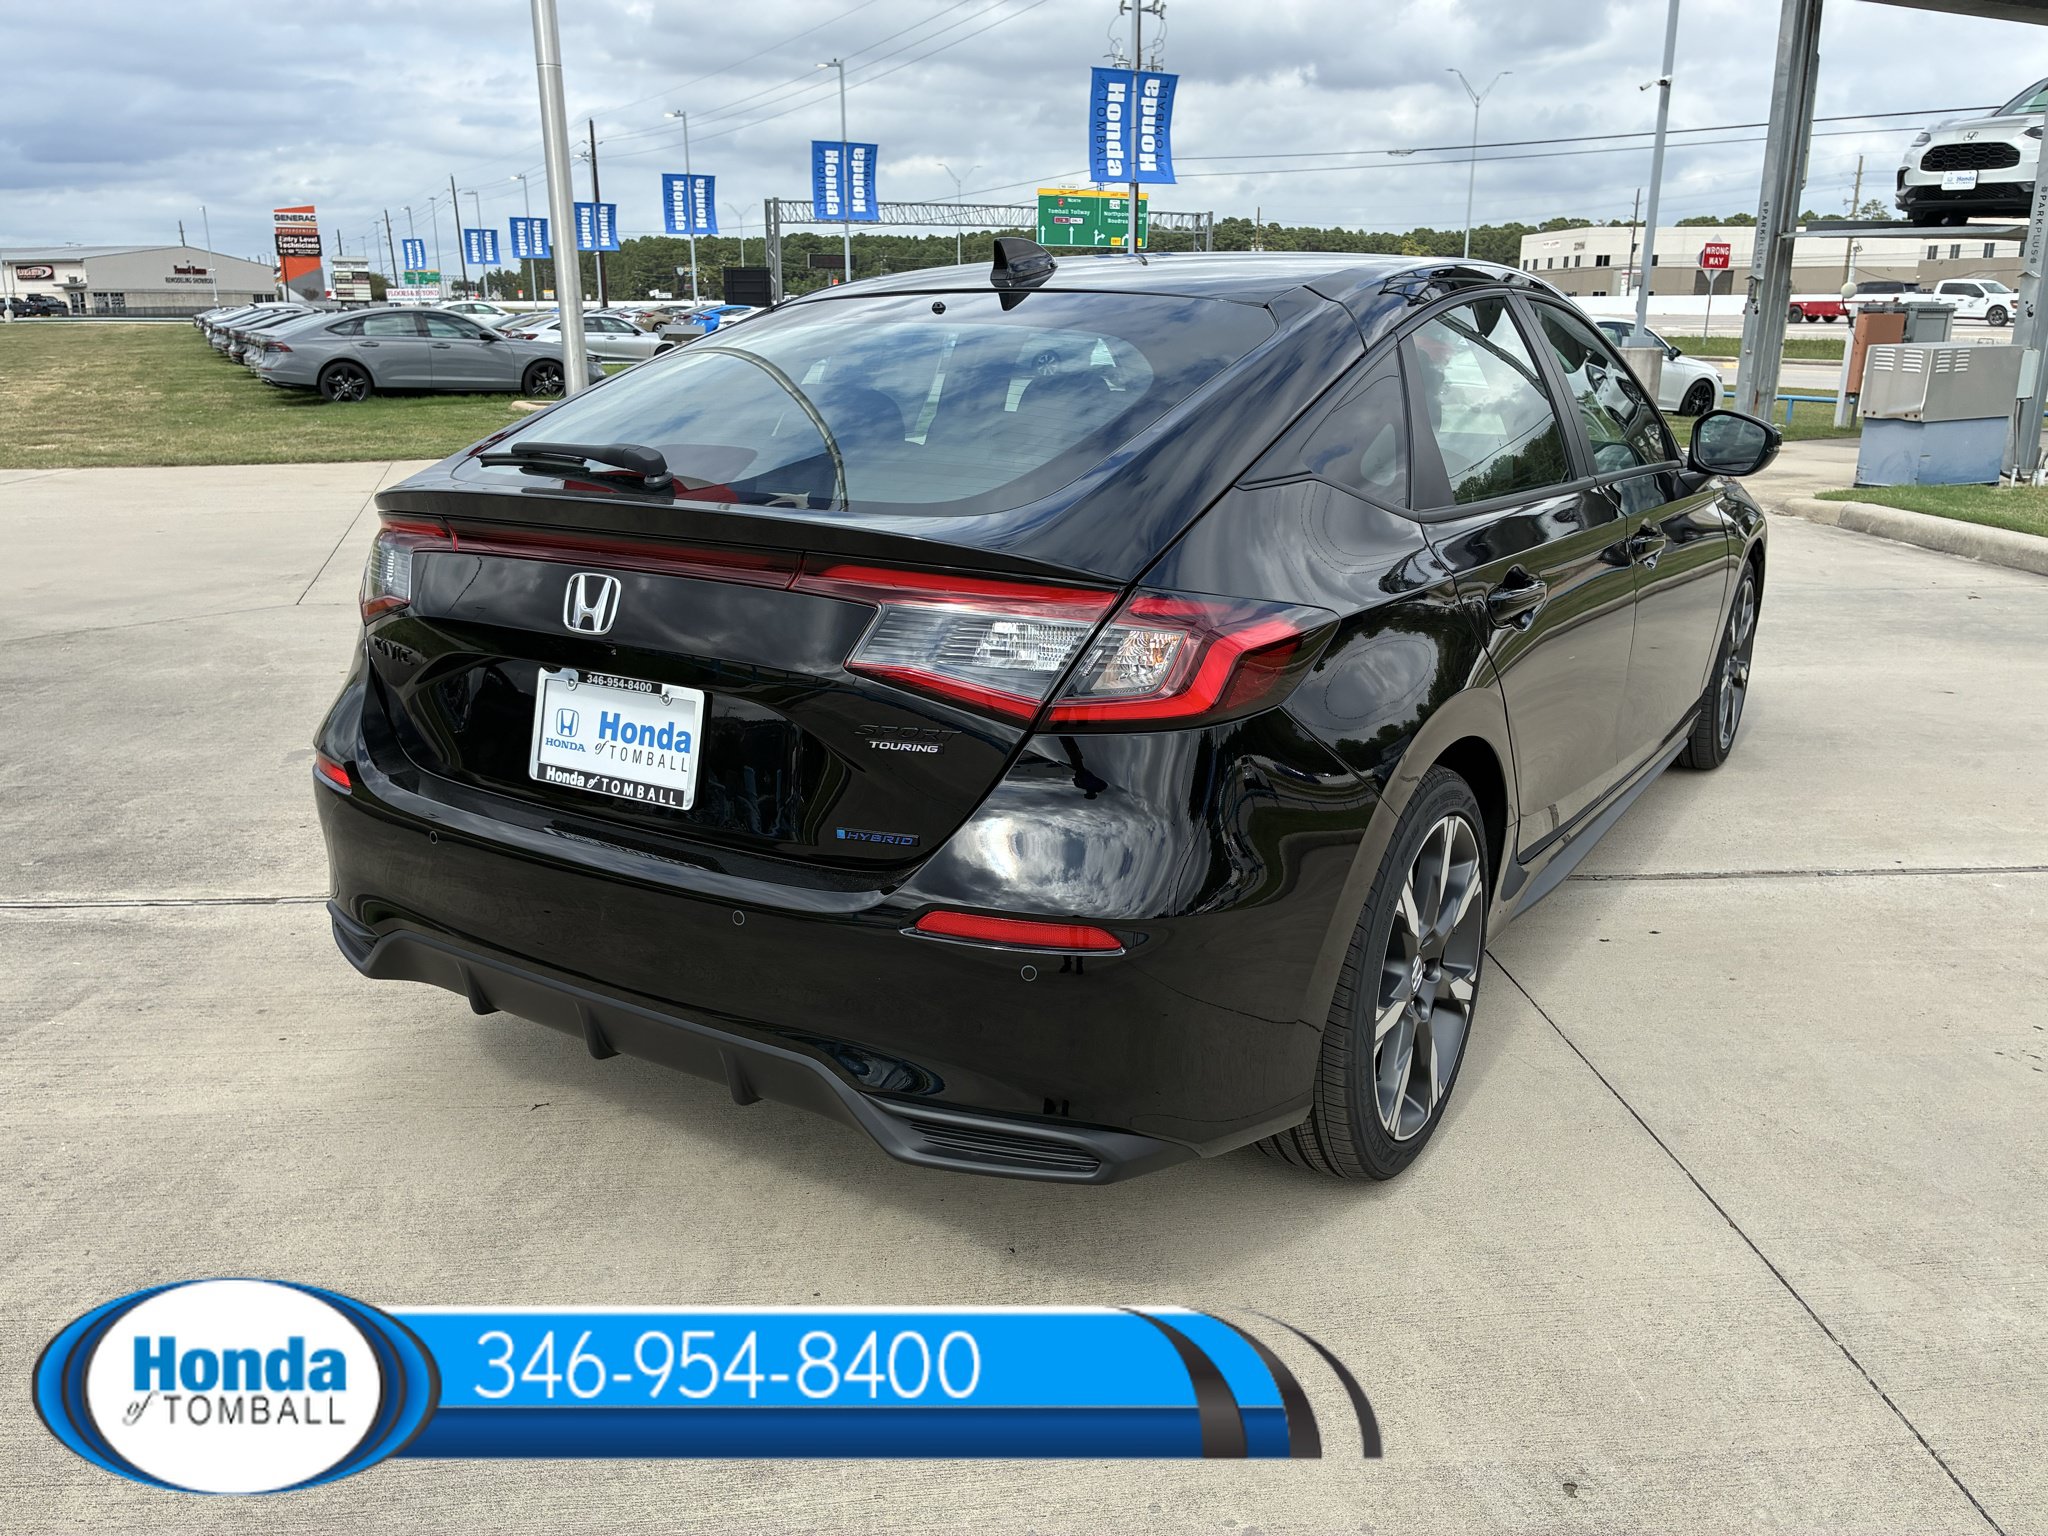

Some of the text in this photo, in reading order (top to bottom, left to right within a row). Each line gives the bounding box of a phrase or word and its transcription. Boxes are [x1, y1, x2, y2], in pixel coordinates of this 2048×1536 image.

[1095, 98, 1107, 174] TOMBALL
[1106, 83, 1126, 176] Honda
[1139, 79, 1160, 171] Honda
[825, 150, 840, 215] Honda
[851, 148, 867, 212] Honda
[274, 214, 316, 222] GENERAC
[672, 181, 687, 231] Honda
[693, 178, 708, 228] Honda
[517, 222, 528, 256] Honda
[533, 221, 544, 254] Honda
[581, 208, 593, 248] Honda
[599, 206, 611, 247] Honda
[1706, 246, 1730, 255] WRONG
[1709, 257, 1724, 265] WAY
[586, 674, 653, 693] 346-954-8400
[545, 737, 586, 752] HONDA
[598, 711, 692, 754] Honda
[854, 724, 963, 742] SPORT
[869, 741, 939, 753] TOURING
[594, 740, 688, 773] of TOMBALL
[546, 766, 677, 805] Honda of TOMBALL
[847, 831, 914, 845] HYBRID
